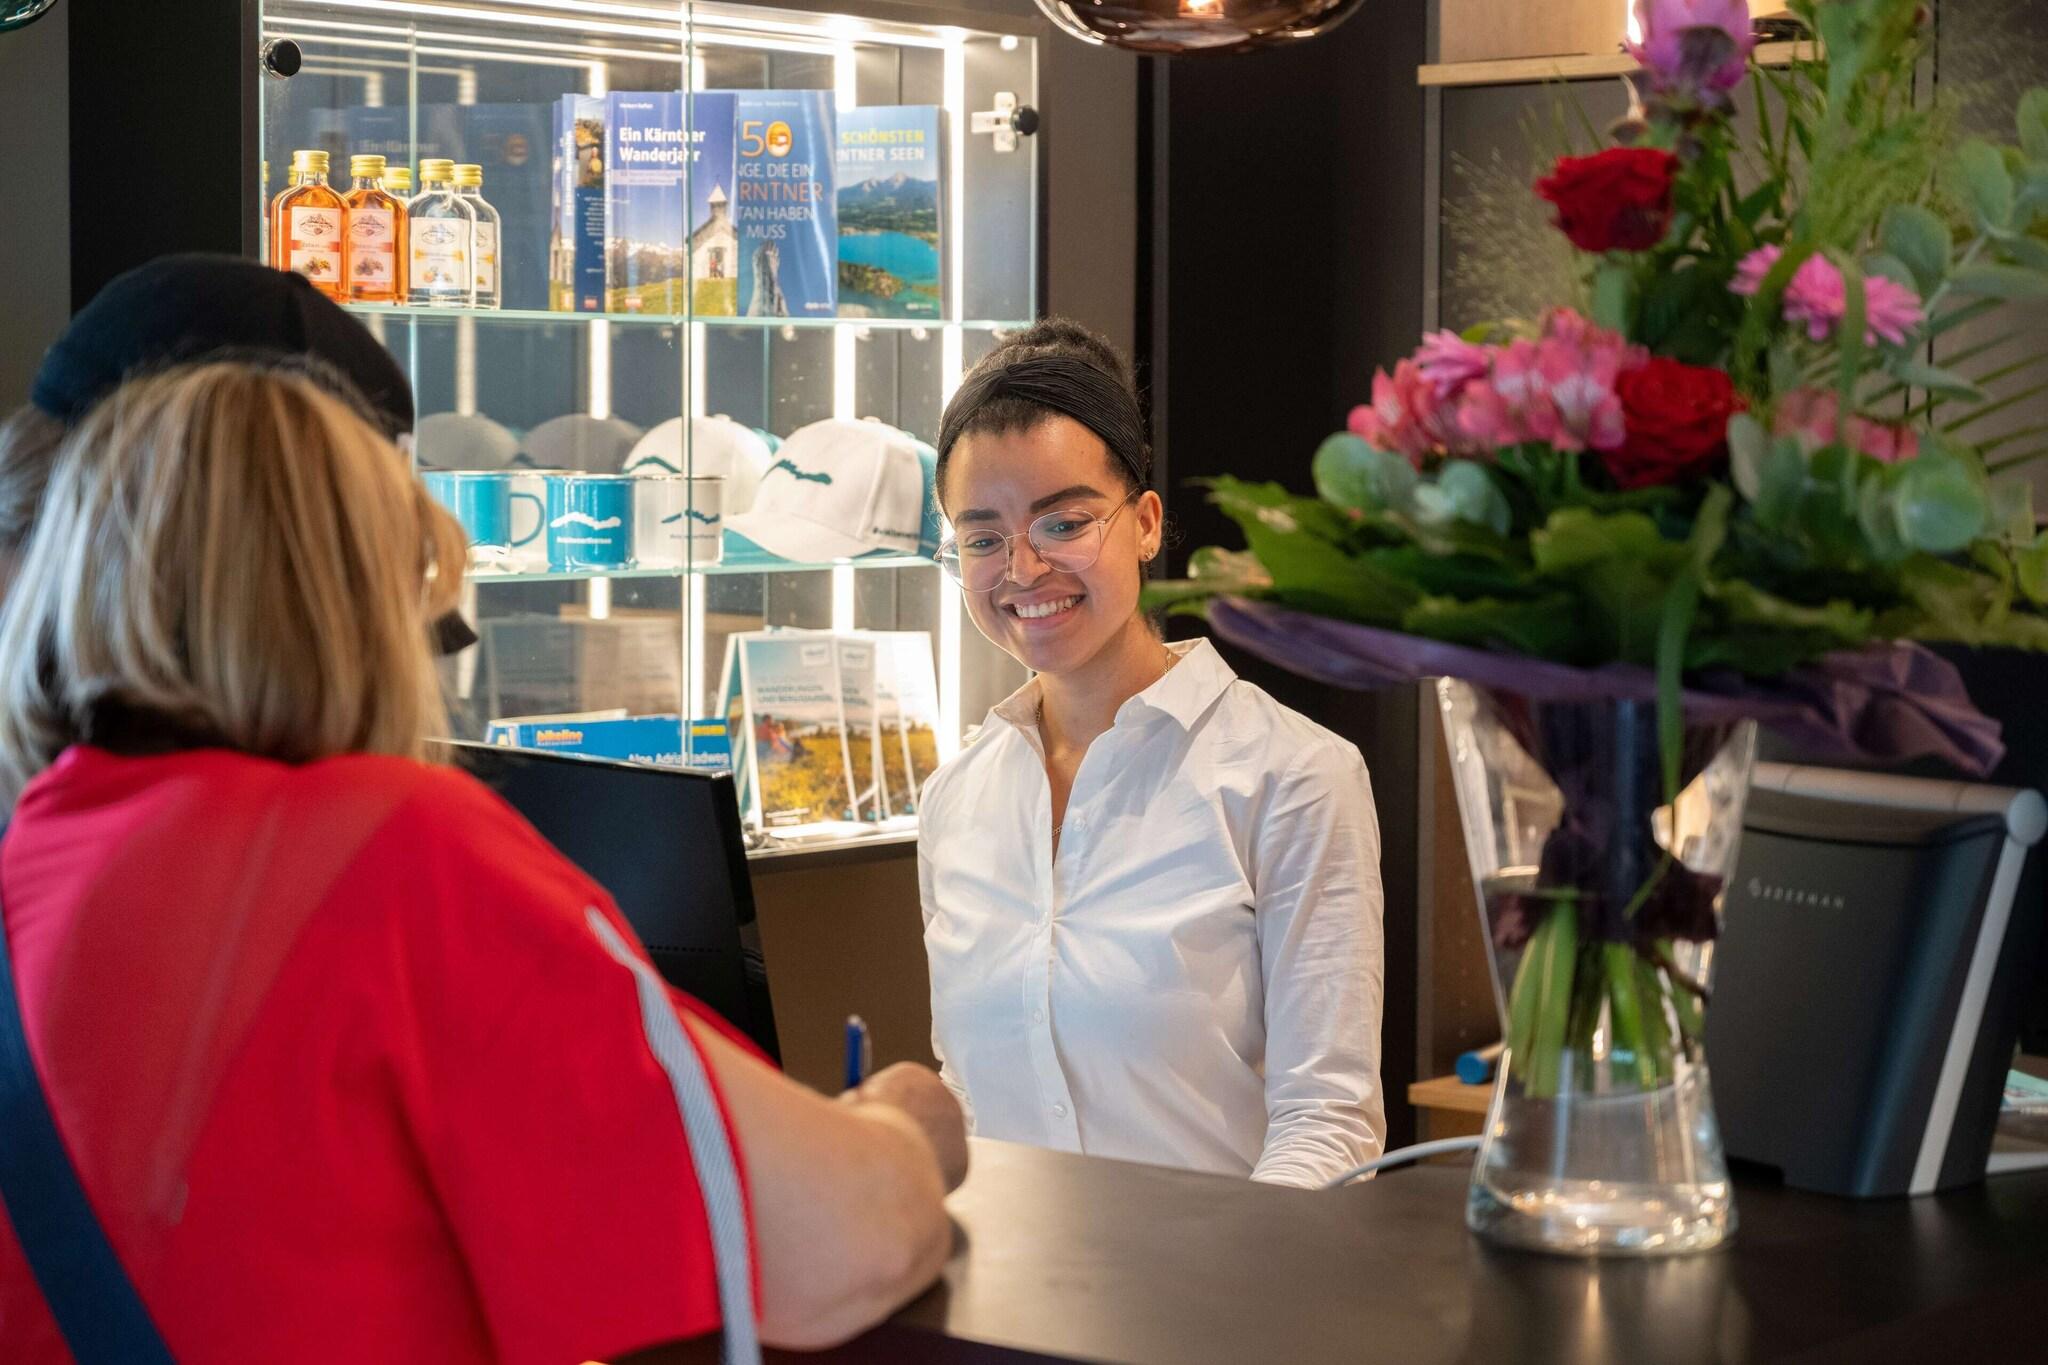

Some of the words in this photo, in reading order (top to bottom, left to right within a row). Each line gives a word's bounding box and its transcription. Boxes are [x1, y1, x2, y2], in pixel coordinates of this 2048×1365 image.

[619, 127, 642, 143] Ein
[742, 120, 793, 158] 50
[842, 127, 925, 145] SCHÖNSTEN
[890, 146, 925, 161] SEEN
[767, 162, 790, 178] DIE
[767, 206, 816, 221] HABEN
[746, 223, 787, 239] MUSS
